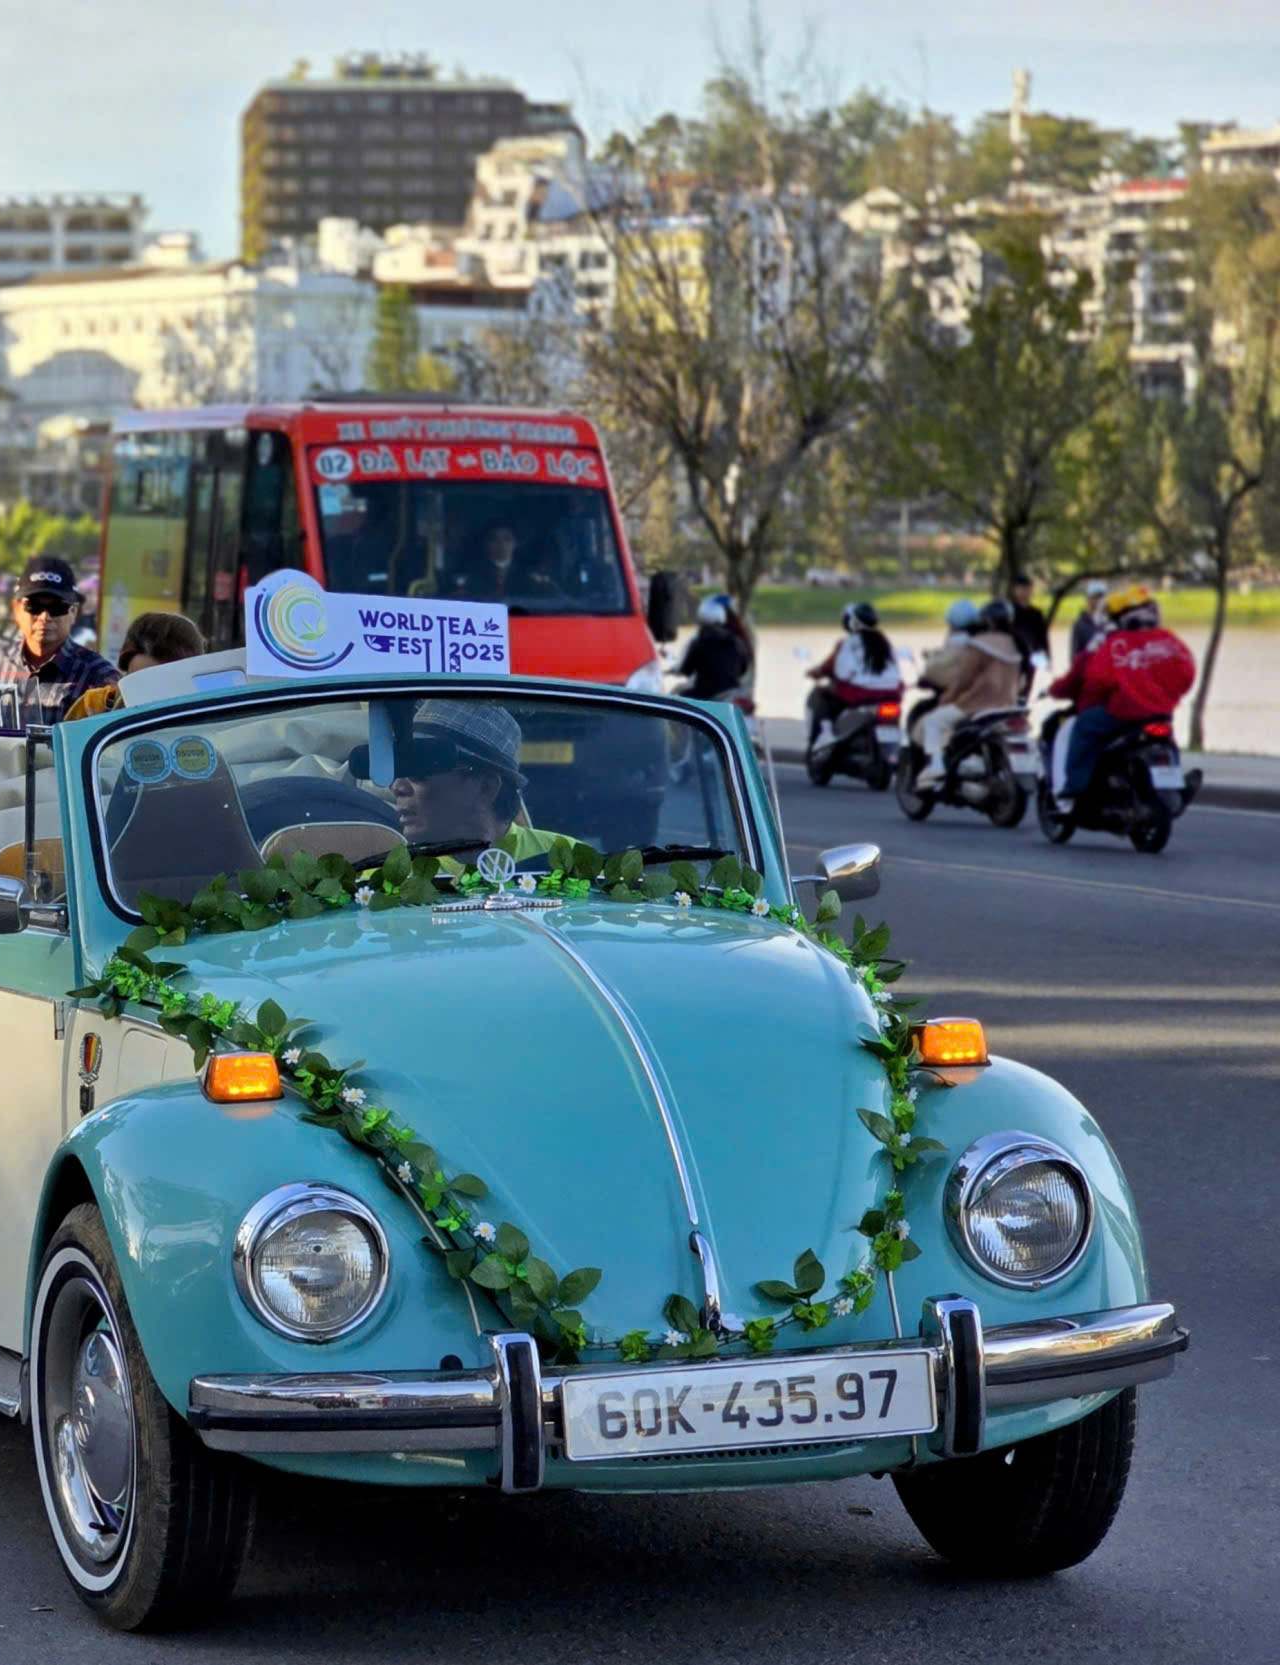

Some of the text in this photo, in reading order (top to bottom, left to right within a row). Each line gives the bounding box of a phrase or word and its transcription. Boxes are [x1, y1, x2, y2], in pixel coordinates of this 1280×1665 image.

[319, 453, 348, 474] 02
[357, 444, 401, 474] ĐÀ
[403, 447, 451, 478] LẠT
[358, 609, 434, 632] WORLD
[449, 641, 505, 672] 2025
[596, 1369, 898, 1440] 60K-435.97
